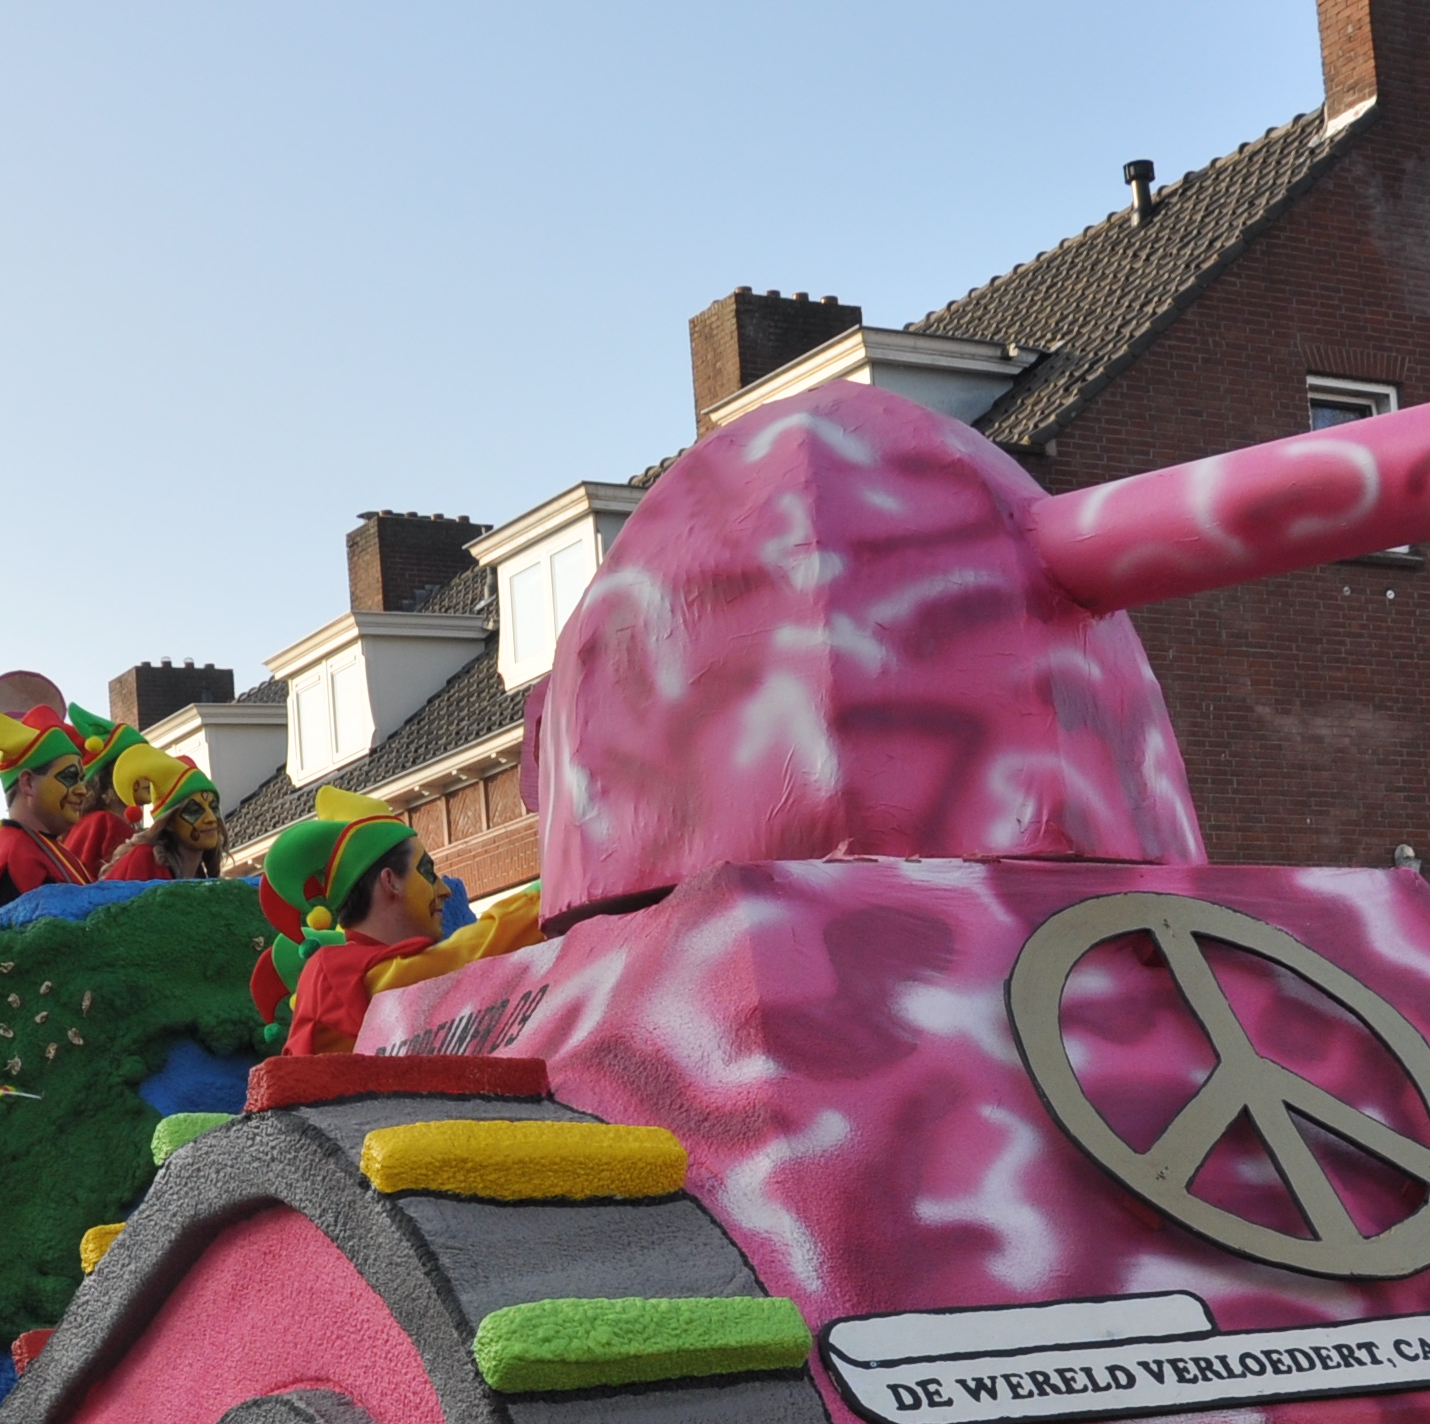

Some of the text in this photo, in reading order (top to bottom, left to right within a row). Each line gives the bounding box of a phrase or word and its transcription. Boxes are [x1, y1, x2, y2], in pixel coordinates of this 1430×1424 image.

[885, 1377, 955, 1412] DE
[954, 1363, 1138, 1405] WERELD
[1137, 1340, 1398, 1387] VERLOEDERT,
